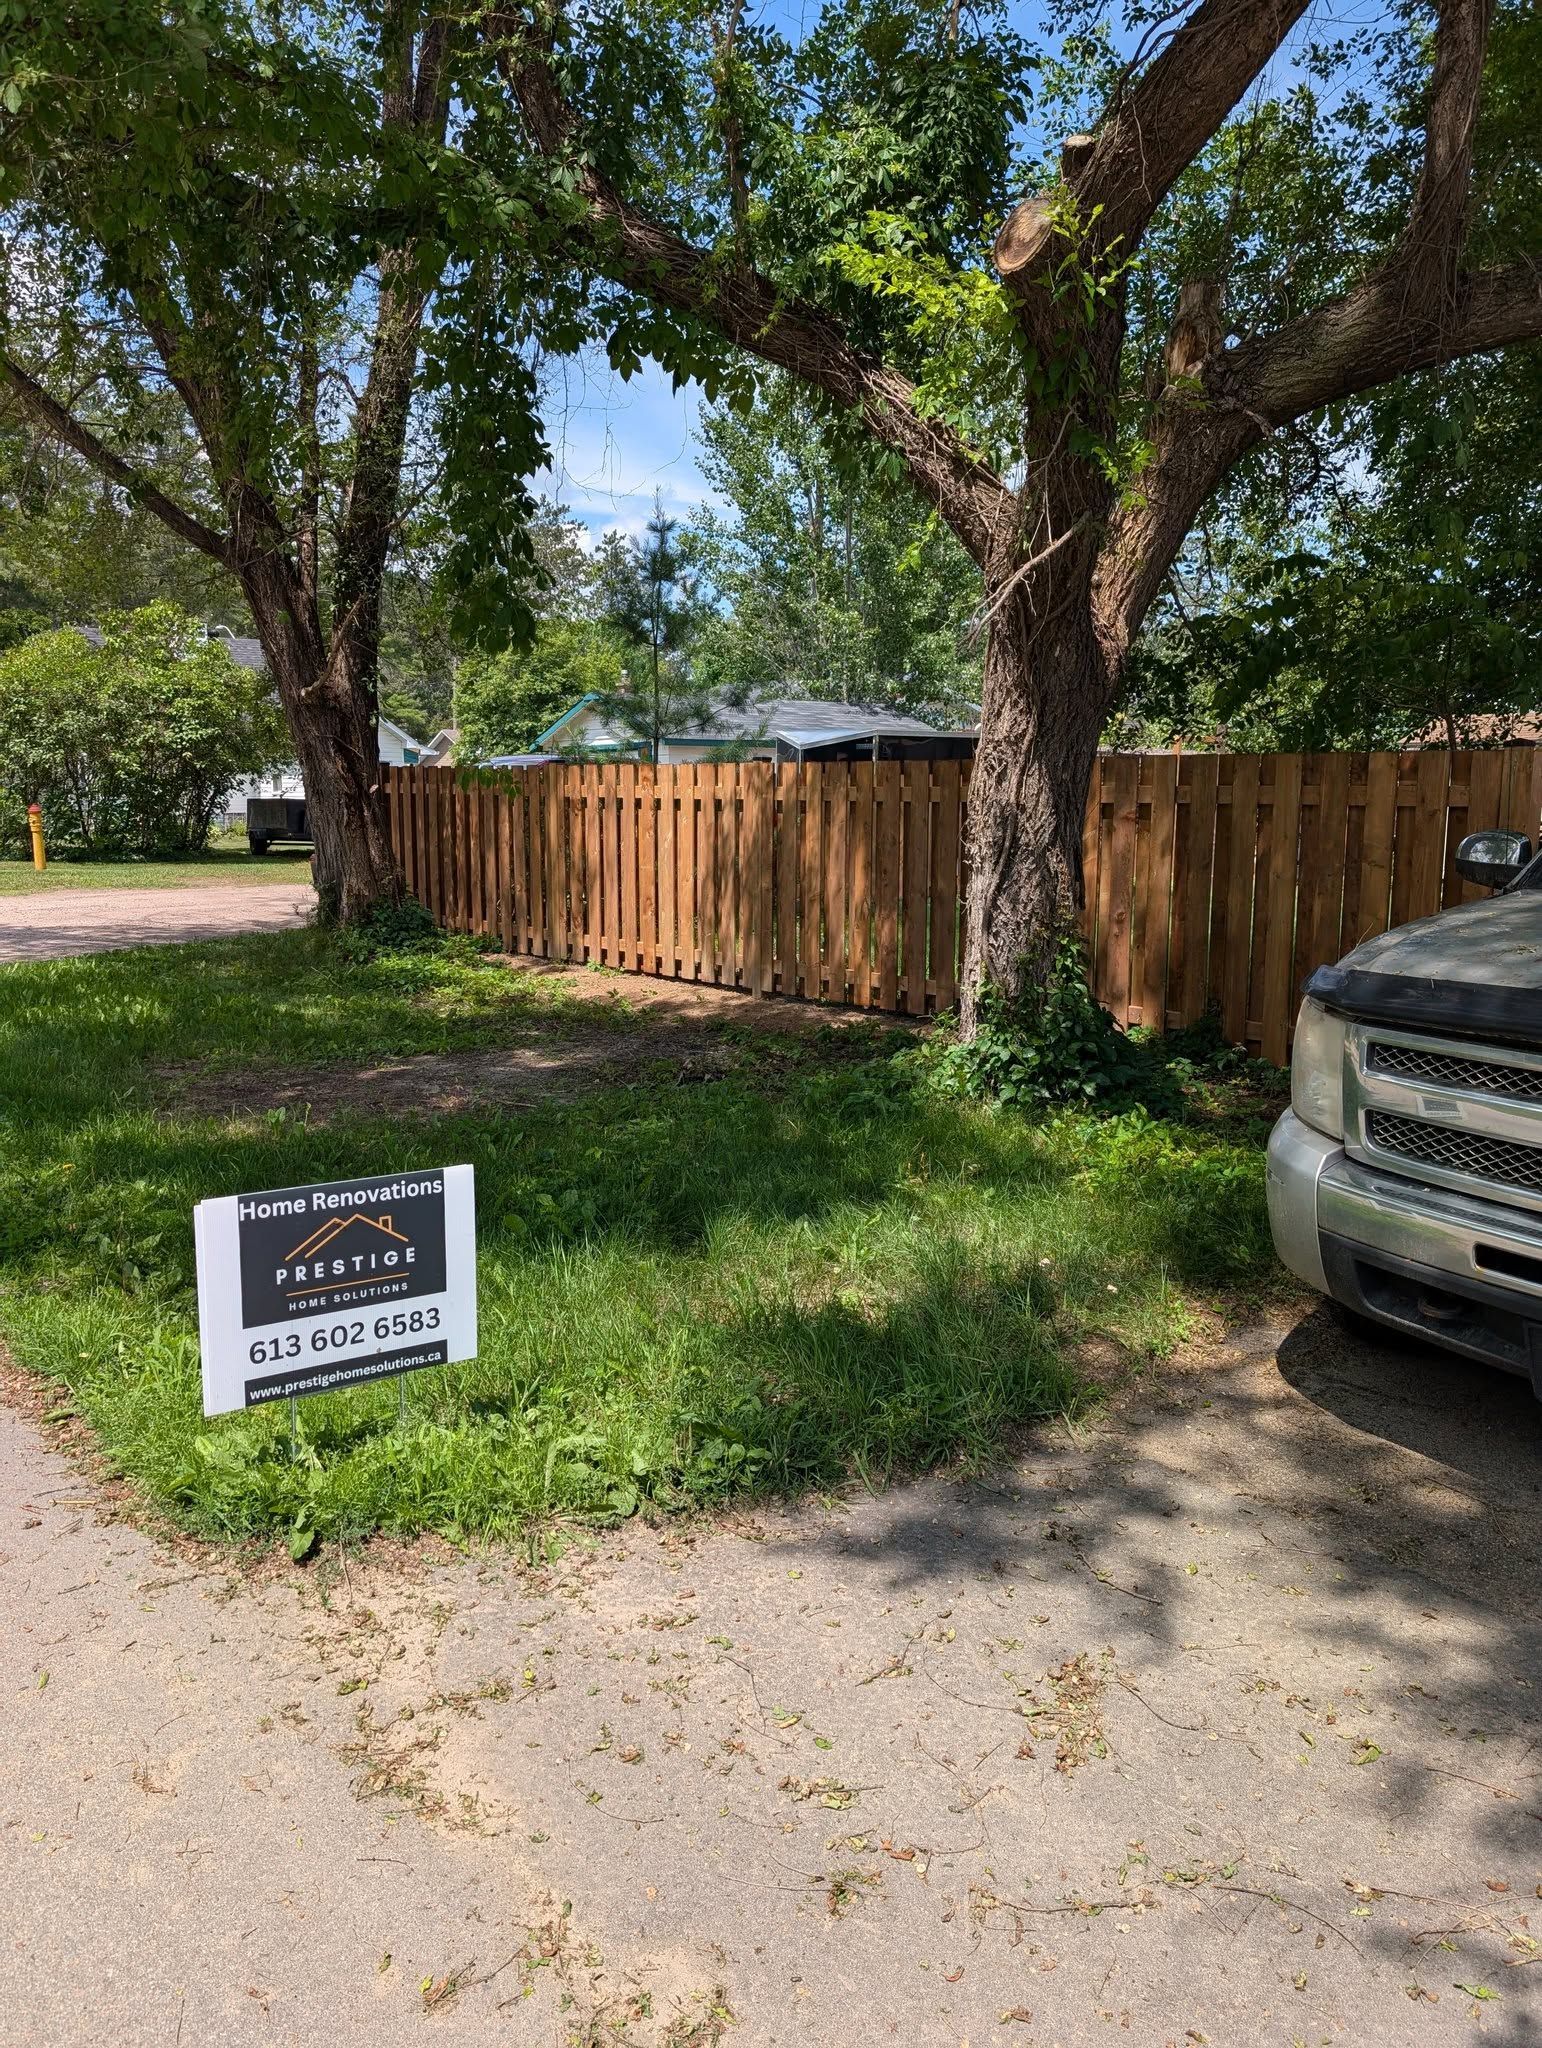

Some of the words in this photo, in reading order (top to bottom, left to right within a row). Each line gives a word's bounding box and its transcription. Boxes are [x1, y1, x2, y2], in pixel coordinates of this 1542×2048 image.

[239, 1196, 306, 1221] Home
[312, 1179, 443, 1211] Renovations
[276, 1247, 416, 1284] PRESTIGE
[289, 1297, 326, 1311] HOME
[334, 1282, 408, 1302] SOLUTIONS
[249, 1335, 301, 1364] 613
[311, 1322, 364, 1351] 602
[374, 1308, 440, 1339] 6583
[250, 1352, 441, 1399] www.prestigehomesolutions.ca
